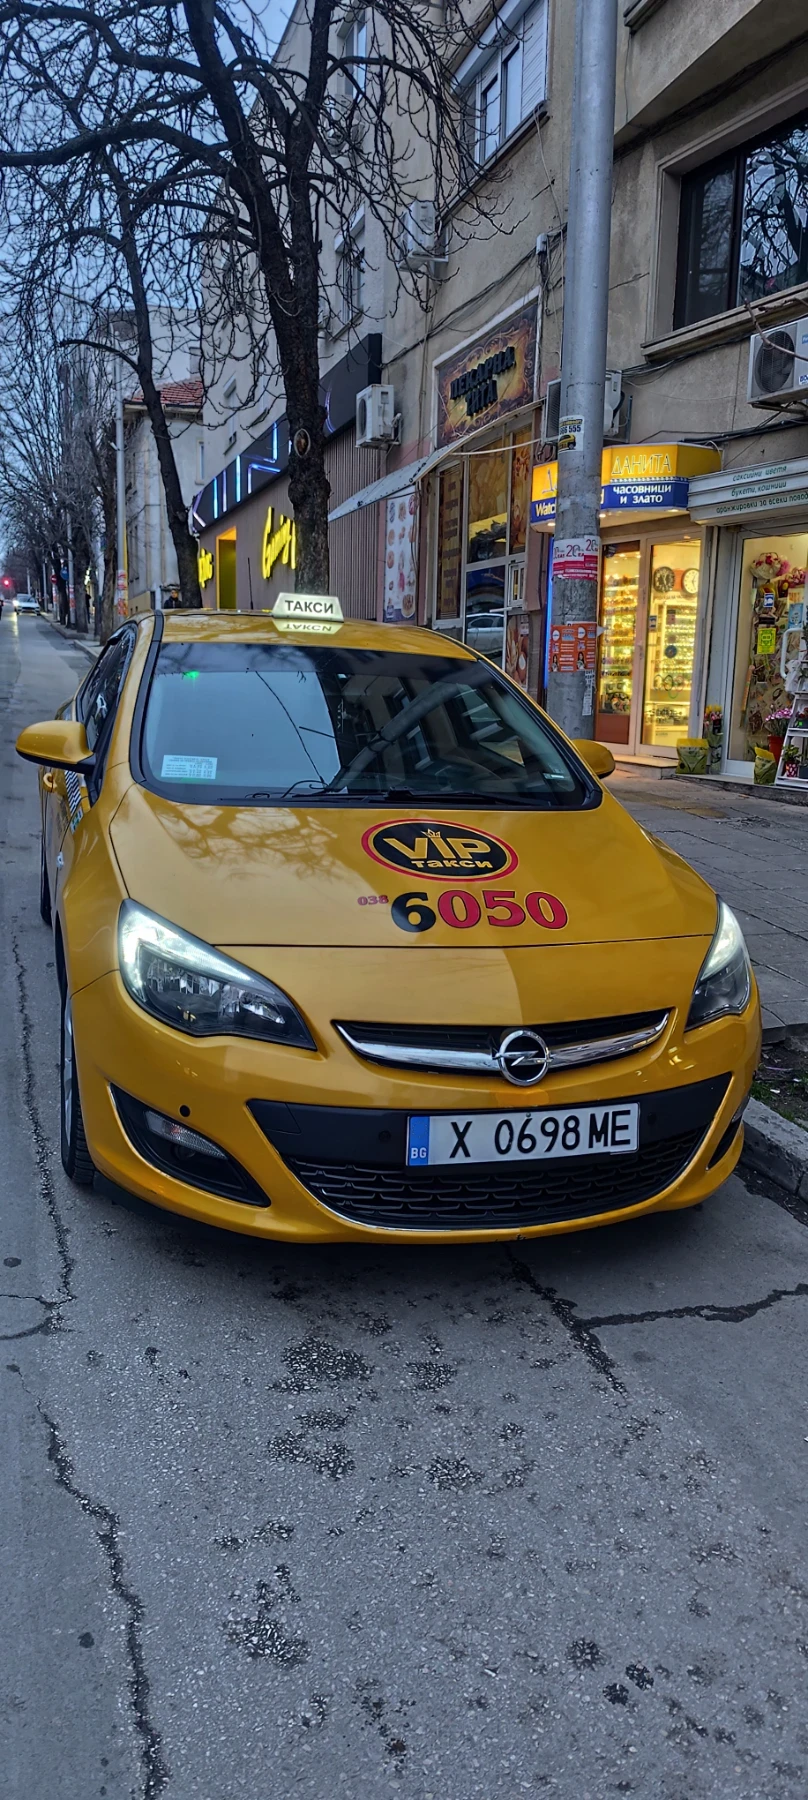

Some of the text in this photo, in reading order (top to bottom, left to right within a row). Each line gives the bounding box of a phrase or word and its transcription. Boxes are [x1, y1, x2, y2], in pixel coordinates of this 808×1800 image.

[568, 424, 581, 433] 555
[612, 453, 672, 475] ДАНИТА
[613, 484, 672, 495] часовници
[620, 495, 663, 504] и злато
[759, 500, 767, 508] за
[768, 496, 787, 507] всеки
[285, 600, 334, 614] ТАКСИ
[383, 836, 491, 859] VIP
[411, 860, 493, 869] такси
[357, 889, 568, 933] 038 6050
[410, 1109, 631, 1160] BG X 0698 ME
